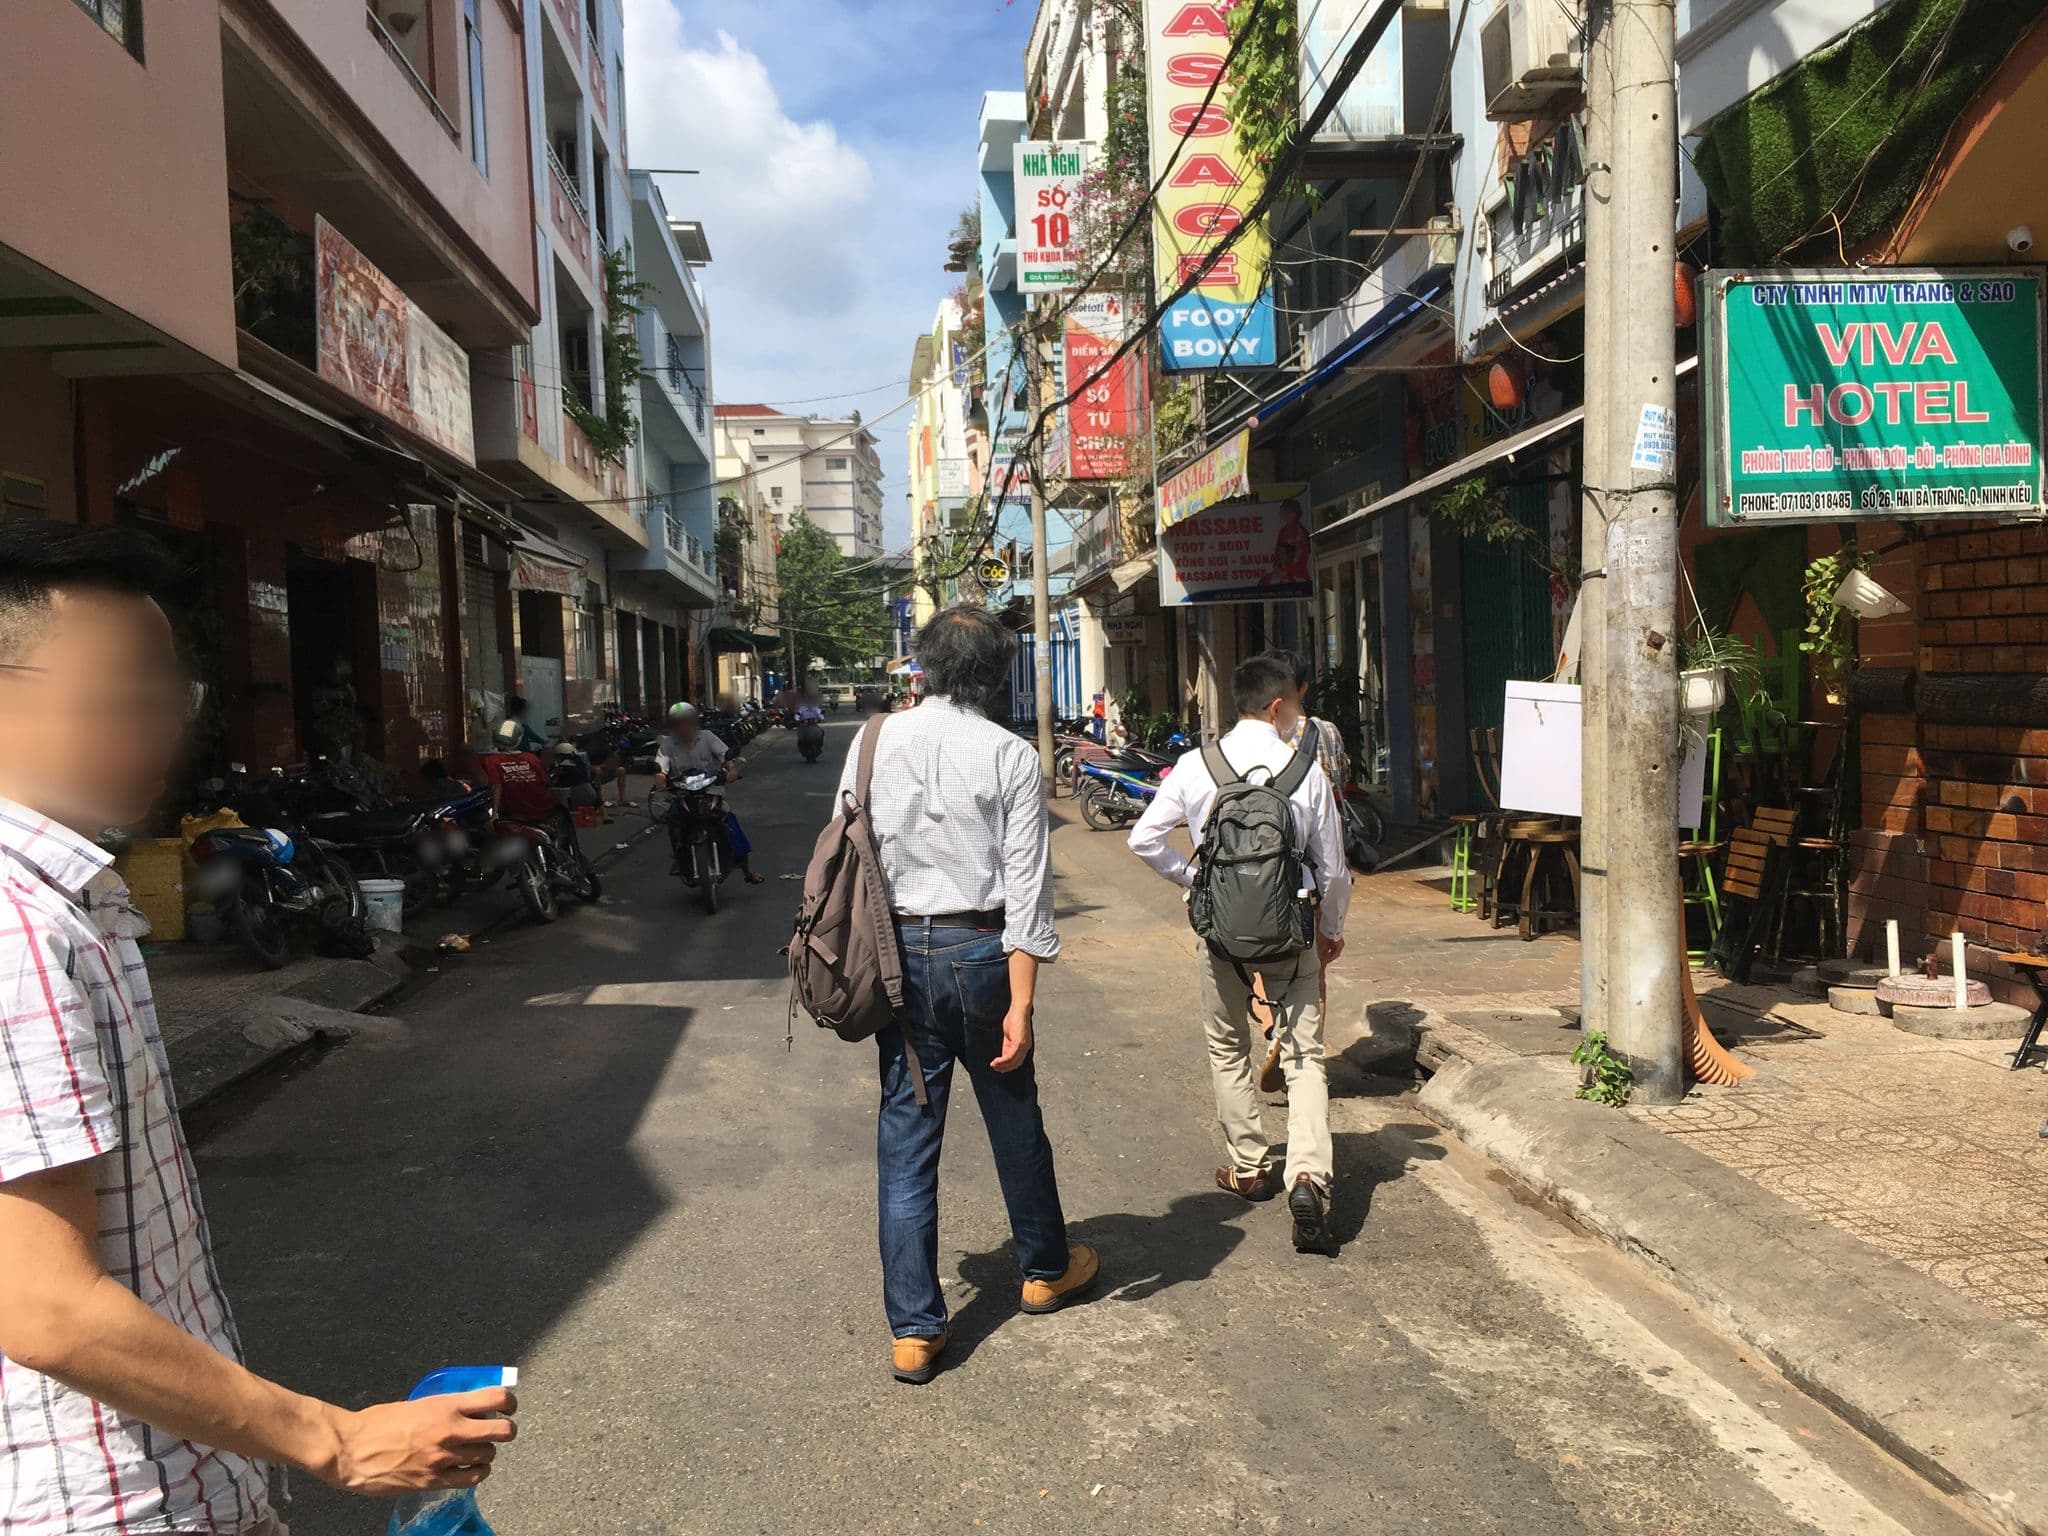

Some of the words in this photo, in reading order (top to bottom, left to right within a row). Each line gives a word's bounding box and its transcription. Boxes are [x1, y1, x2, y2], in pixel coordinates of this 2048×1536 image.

[1023, 149, 1048, 176] NHÀ
[1031, 213, 1070, 248] 10
[1040, 250, 1061, 263] KHOA
[1753, 284, 1789, 305] CTY
[1793, 284, 1844, 304] TNHH
[1848, 284, 1888, 304] MTV
[1959, 282, 1973, 303] &
[1979, 281, 2016, 303] SAO
[1172, 309, 1256, 327] FOOT
[1173, 338, 1260, 357] BODY
[1816, 322, 1958, 367] VIVA
[1784, 381, 1990, 428] HOTEL
[1742, 446, 1781, 473] PHÒNG
[1783, 445, 1812, 472] THUÊ
[1843, 444, 1881, 470] PHÒNG
[1944, 441, 1982, 468] PHÒNG
[1984, 445, 2002, 468] GIA
[1741, 494, 1779, 512] PHONE:
[1781, 493, 1811, 511] 07103
[1815, 492, 1852, 510] 818485
[1862, 485, 1878, 509] SỐ
[1896, 490, 1913, 507] HAI
[1915, 485, 1930, 507] BÀ
[1970, 488, 1980, 507] Q.
[1982, 487, 2006, 506] NINH
[1168, 516, 1264, 537] MASSAGE
[1174, 542, 1205, 554] FOOT
[1218, 540, 1251, 552] BODY
[1176, 571, 1227, 583] MASSAGE
